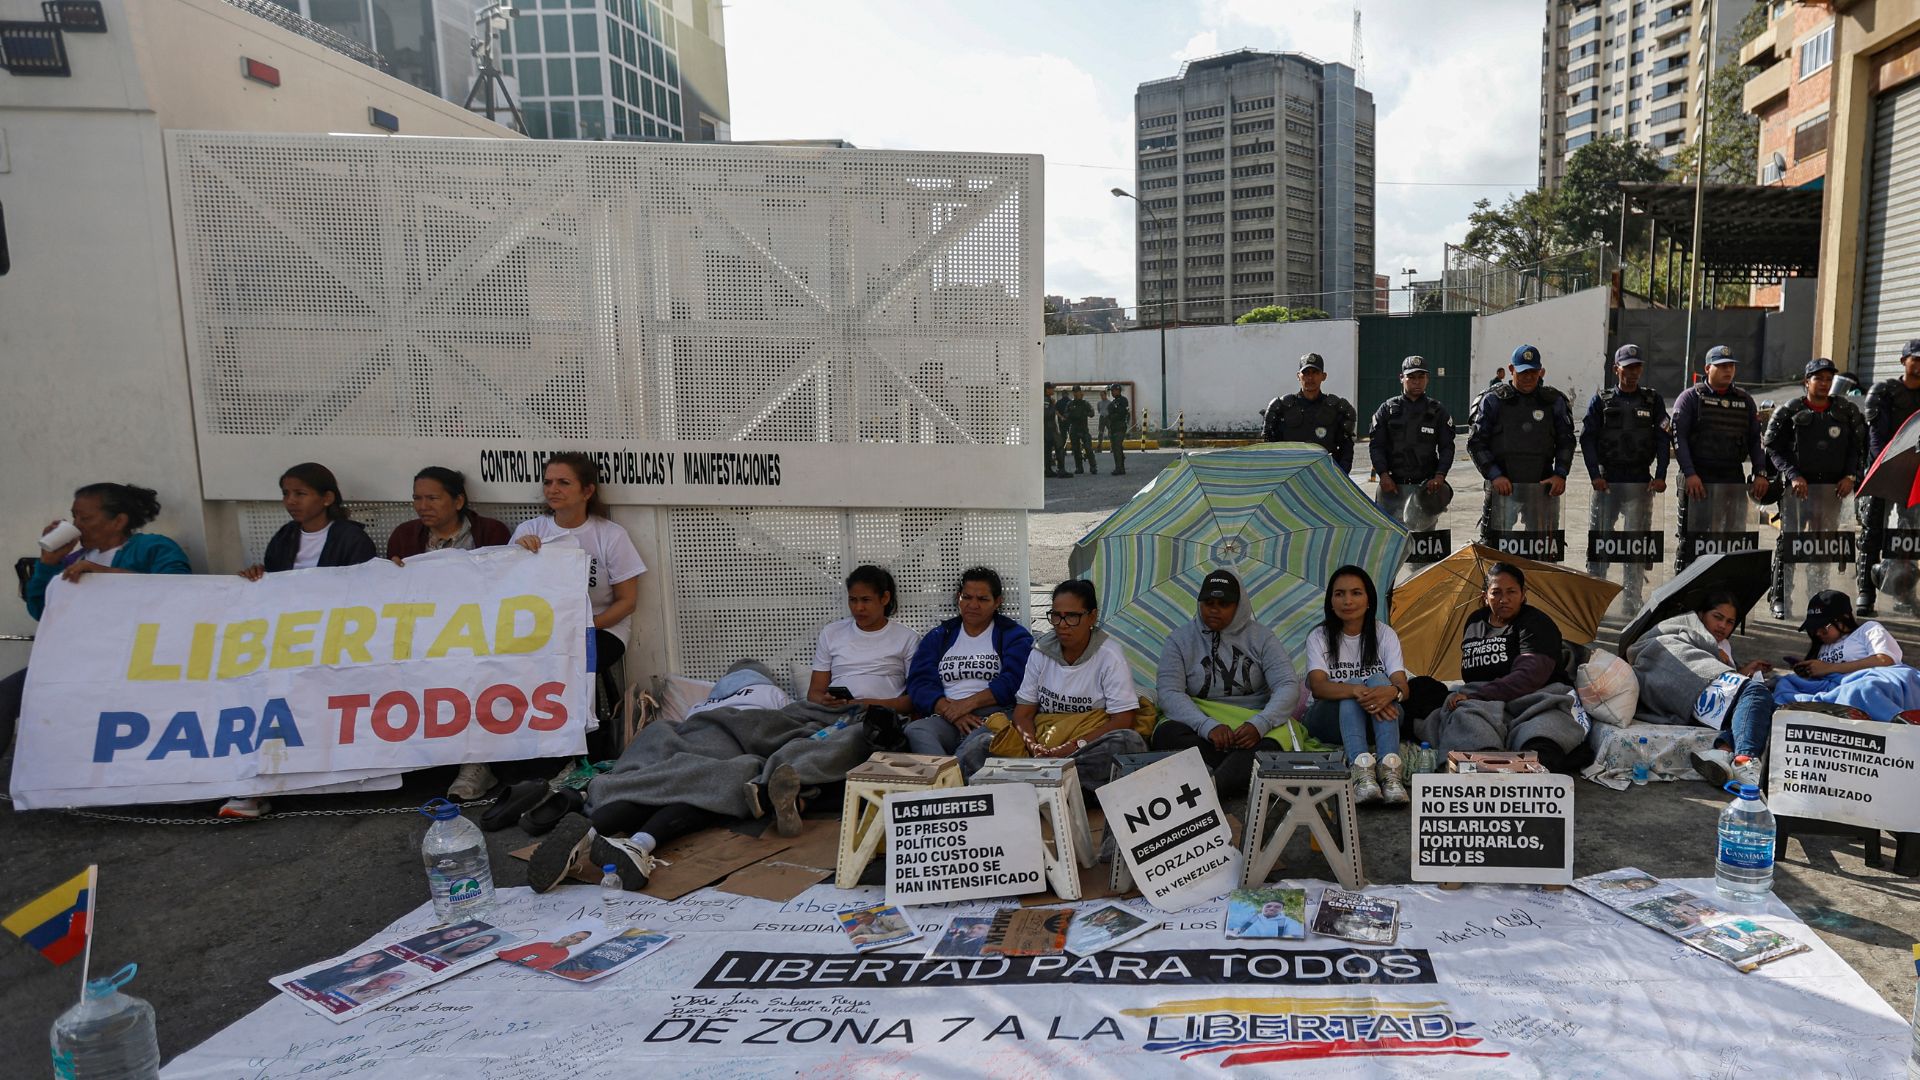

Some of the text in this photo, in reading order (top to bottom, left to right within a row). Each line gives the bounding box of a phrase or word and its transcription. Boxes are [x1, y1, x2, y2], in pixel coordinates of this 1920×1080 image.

[480, 450, 531, 482] CONTROL
[533, 451, 546, 483] DE
[614, 448, 664, 485] PÚBLICAS
[666, 452, 675, 485] Y
[684, 452, 781, 486] MANIFESTACIONES
[1411, 536, 1444, 555] ICÍA
[1500, 536, 1558, 556] POLICÍA
[1595, 536, 1657, 556] POLICÍA
[1694, 538, 1754, 556] POLICÍA
[1792, 538, 1850, 556] POLICÍA
[126, 594, 555, 681] LIBERTAD
[1472, 643, 1506, 656] PRESOS
[958, 660, 1000, 670] PRESOS
[1329, 660, 1354, 670] LIBEREN
[1462, 652, 1508, 669] POLÍTICOS
[939, 669, 1000, 682] POLÍTICOS
[1330, 666, 1385, 679] LOS PRESOS
[1052, 700, 1092, 712] PRESOS
[92, 682, 568, 762] PARA TODOS
[1786, 728, 1881, 752] EN VENEZUELA,
[1786, 744, 1914, 770] LA REVICTIMIZACIÓN
[1784, 770, 1827, 782] SE HAN
[1785, 757, 1879, 778] Y LA INJUSTICIA
[1422, 786, 1566, 798] PENSAR DISTINTO
[1783, 783, 1872, 802] NORMALIZADO
[894, 800, 988, 819] LAS MUERTES
[1124, 797, 1172, 834] NO
[1422, 802, 1562, 814] NO ES UN DELITO.
[896, 820, 968, 837] DE PRESOS
[1420, 820, 1526, 833] AISLARLOS Y
[896, 834, 966, 851] POLÍTICOS
[1137, 816, 1214, 858] DESAPARICIONES
[1420, 835, 1544, 850] TORTURARLOS,
[896, 846, 1004, 865] BAJO CUSTODIA
[1144, 835, 1224, 882] FORZADAS
[1420, 848, 1485, 864] SÍ LO ES
[896, 860, 1000, 879] DEL ESTADO SE
[1156, 856, 1230, 898] EN VENEZUELA
[896, 871, 1039, 894] HAN INTENSIFICADO
[449, 888, 482, 902] minalba
[1338, 898, 1376, 908] OSCAR
[1328, 901, 1384, 913] GRATEROL
[1180, 920, 1218, 930] LOS
[714, 954, 1421, 982] LIBERTAD PARA TODOS
[643, 1013, 1455, 1044] DE ZONA 7 A LA LIBERTAD
